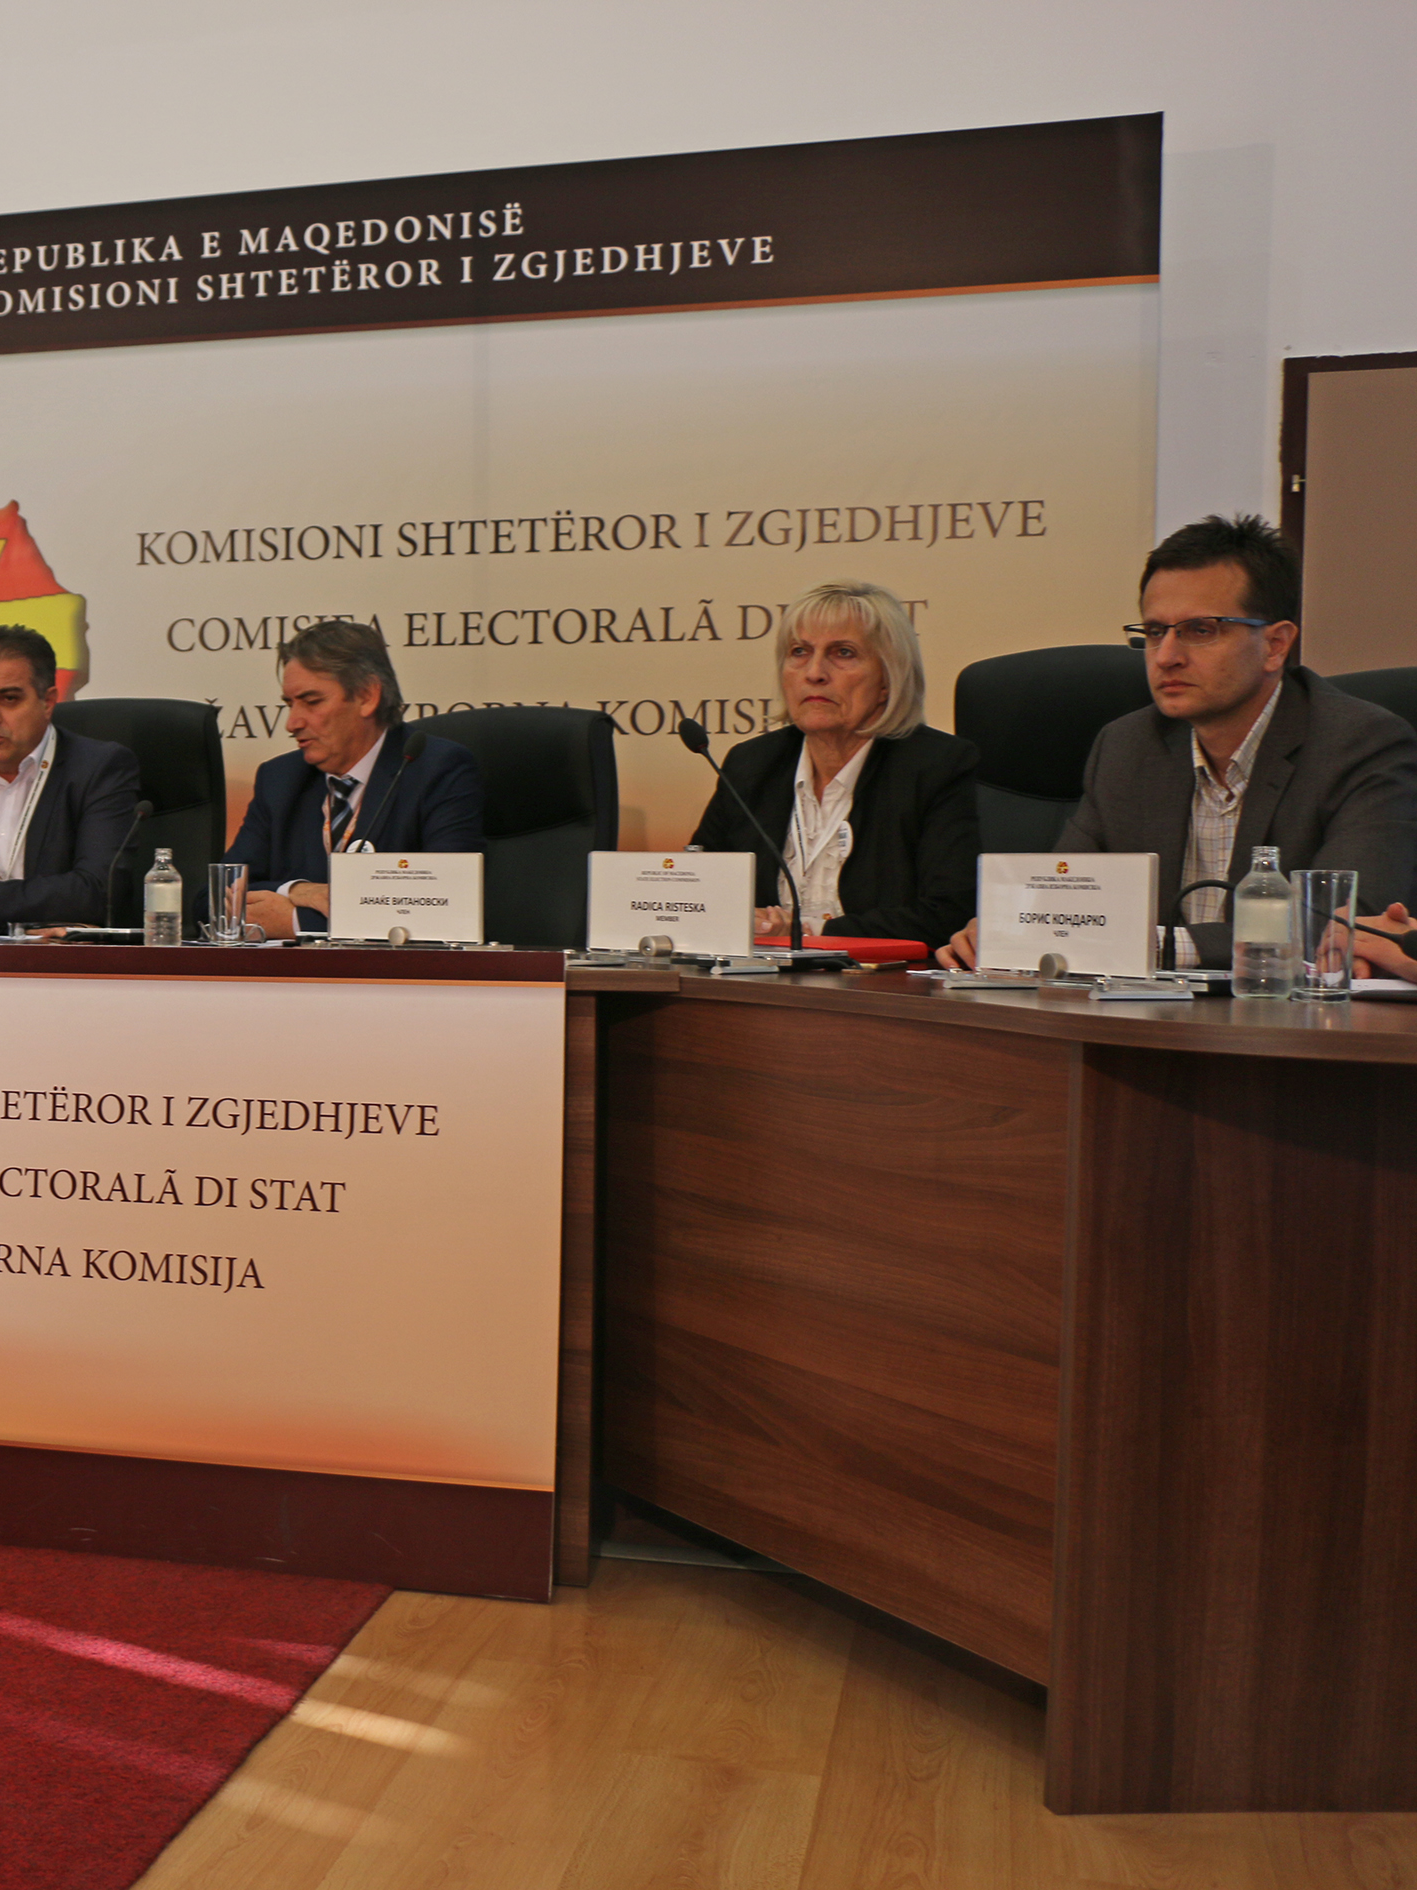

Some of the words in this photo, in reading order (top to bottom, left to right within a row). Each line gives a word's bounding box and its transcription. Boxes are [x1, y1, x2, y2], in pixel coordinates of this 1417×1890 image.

[201, 231, 222, 259] E
[238, 202, 524, 255] MAQEDONISË
[196, 258, 442, 302] SHTETËROR
[460, 255, 474, 283] I
[492, 235, 775, 282] ZGJEDHJEVE
[136, 522, 383, 565] KOMISIONI
[397, 510, 682, 557] SHTETËROR
[695, 512, 710, 548] I
[724, 499, 1047, 553] ZGJEDHJEVE
[596, 698, 773, 736] KOMISI
[630, 900, 664, 912] RADICA
[665, 902, 706, 913] RISTESKA
[1019, 912, 1051, 925] БОРИС
[1052, 913, 1107, 928] КОНДАРКО
[162, 1096, 175, 1127] I
[185, 1096, 440, 1140] ZGJEDHJEVE
[194, 1175, 239, 1208] DI
[249, 1177, 346, 1213] STAT
[82, 1248, 265, 1294] KOMISIJA
